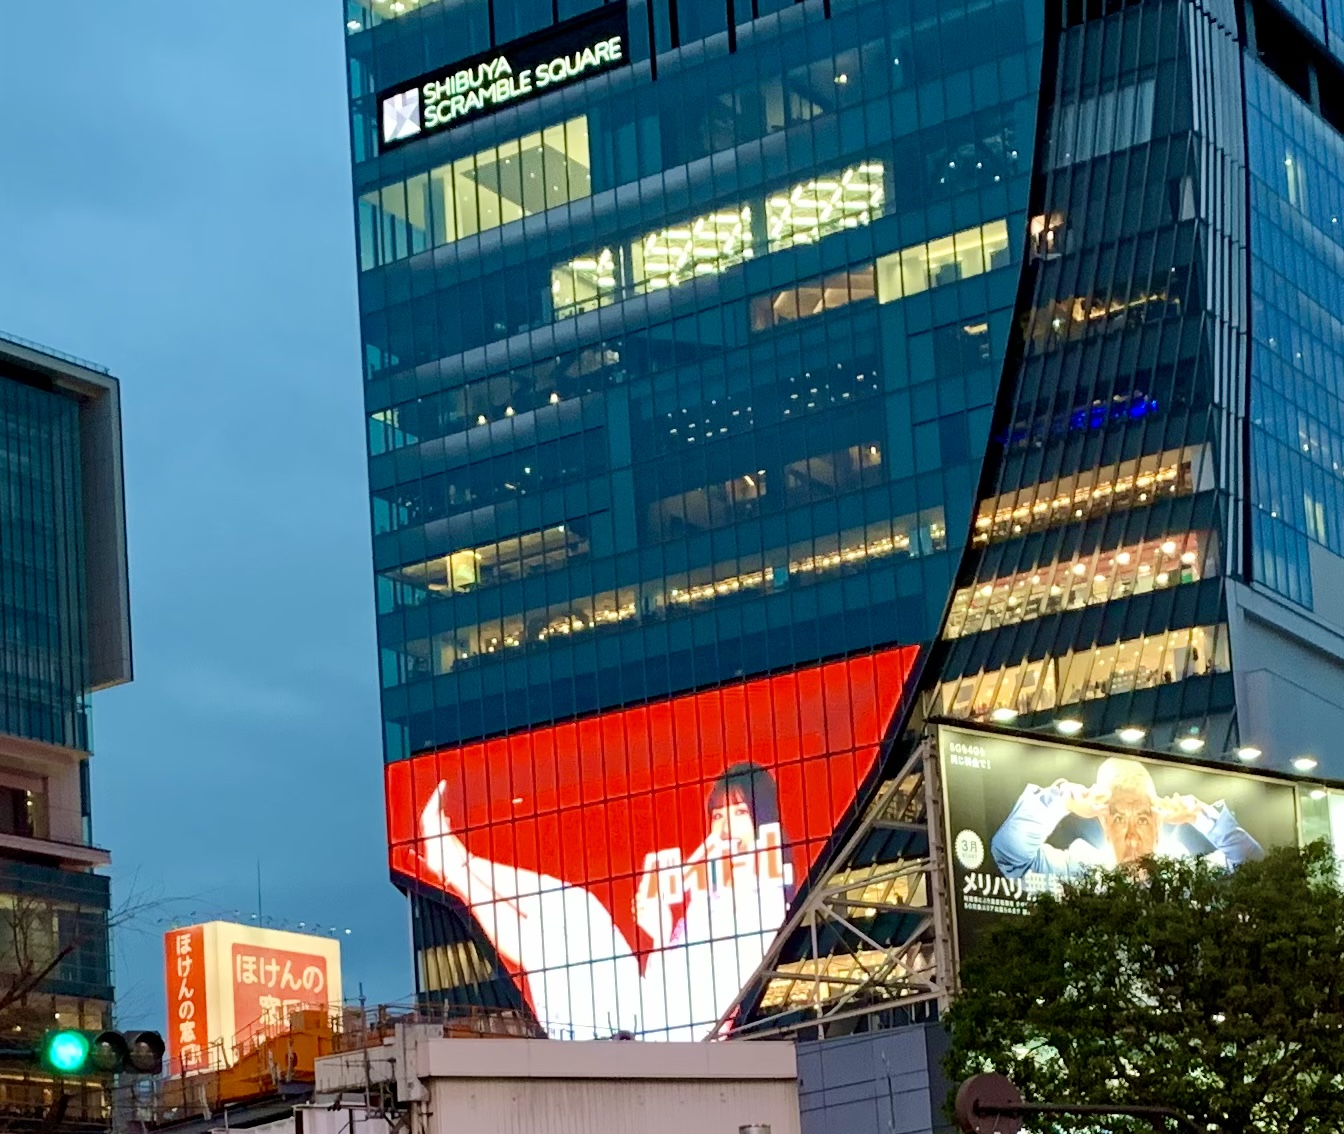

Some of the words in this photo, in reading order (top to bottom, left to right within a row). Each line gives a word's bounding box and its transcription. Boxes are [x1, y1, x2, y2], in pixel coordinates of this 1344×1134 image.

[423, 56, 512, 105] SHIBUYA
[424, 70, 532, 128] SCRAMBLE
[535, 35, 622, 88] SQUARE
[236, 953, 324, 993] ほけんの
